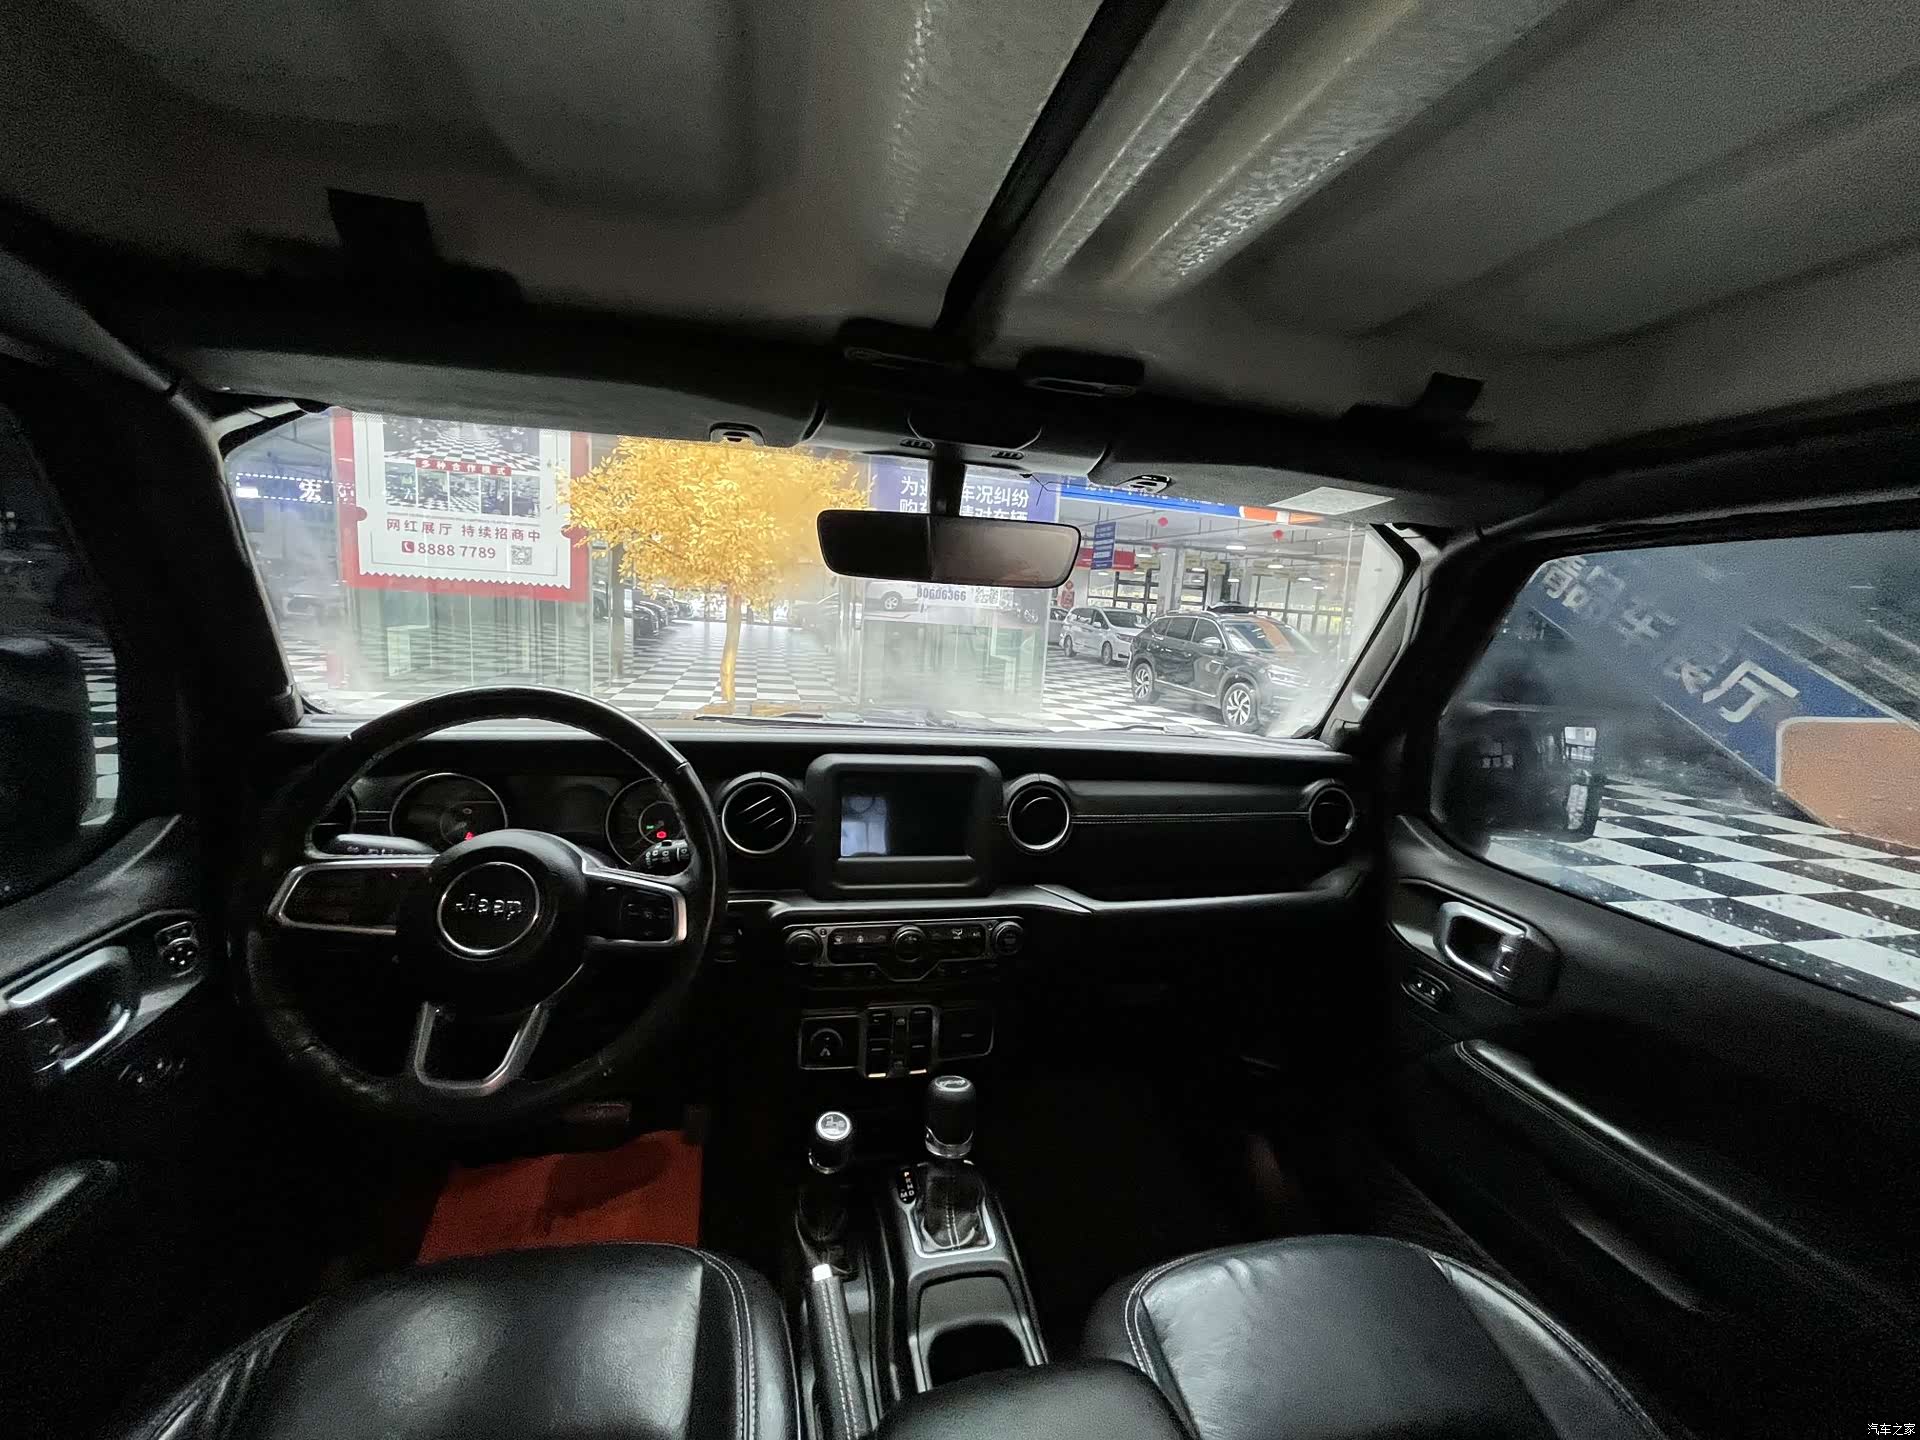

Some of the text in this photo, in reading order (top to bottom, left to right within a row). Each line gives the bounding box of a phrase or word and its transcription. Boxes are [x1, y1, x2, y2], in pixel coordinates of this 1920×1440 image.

[420, 459, 506, 475] 多种合作模式
[387, 518, 453, 535] 网红展厅
[461, 524, 540, 543] 持续招商中
[418, 543, 496, 559] 8888 7789
[455, 893, 522, 920] Jeep
